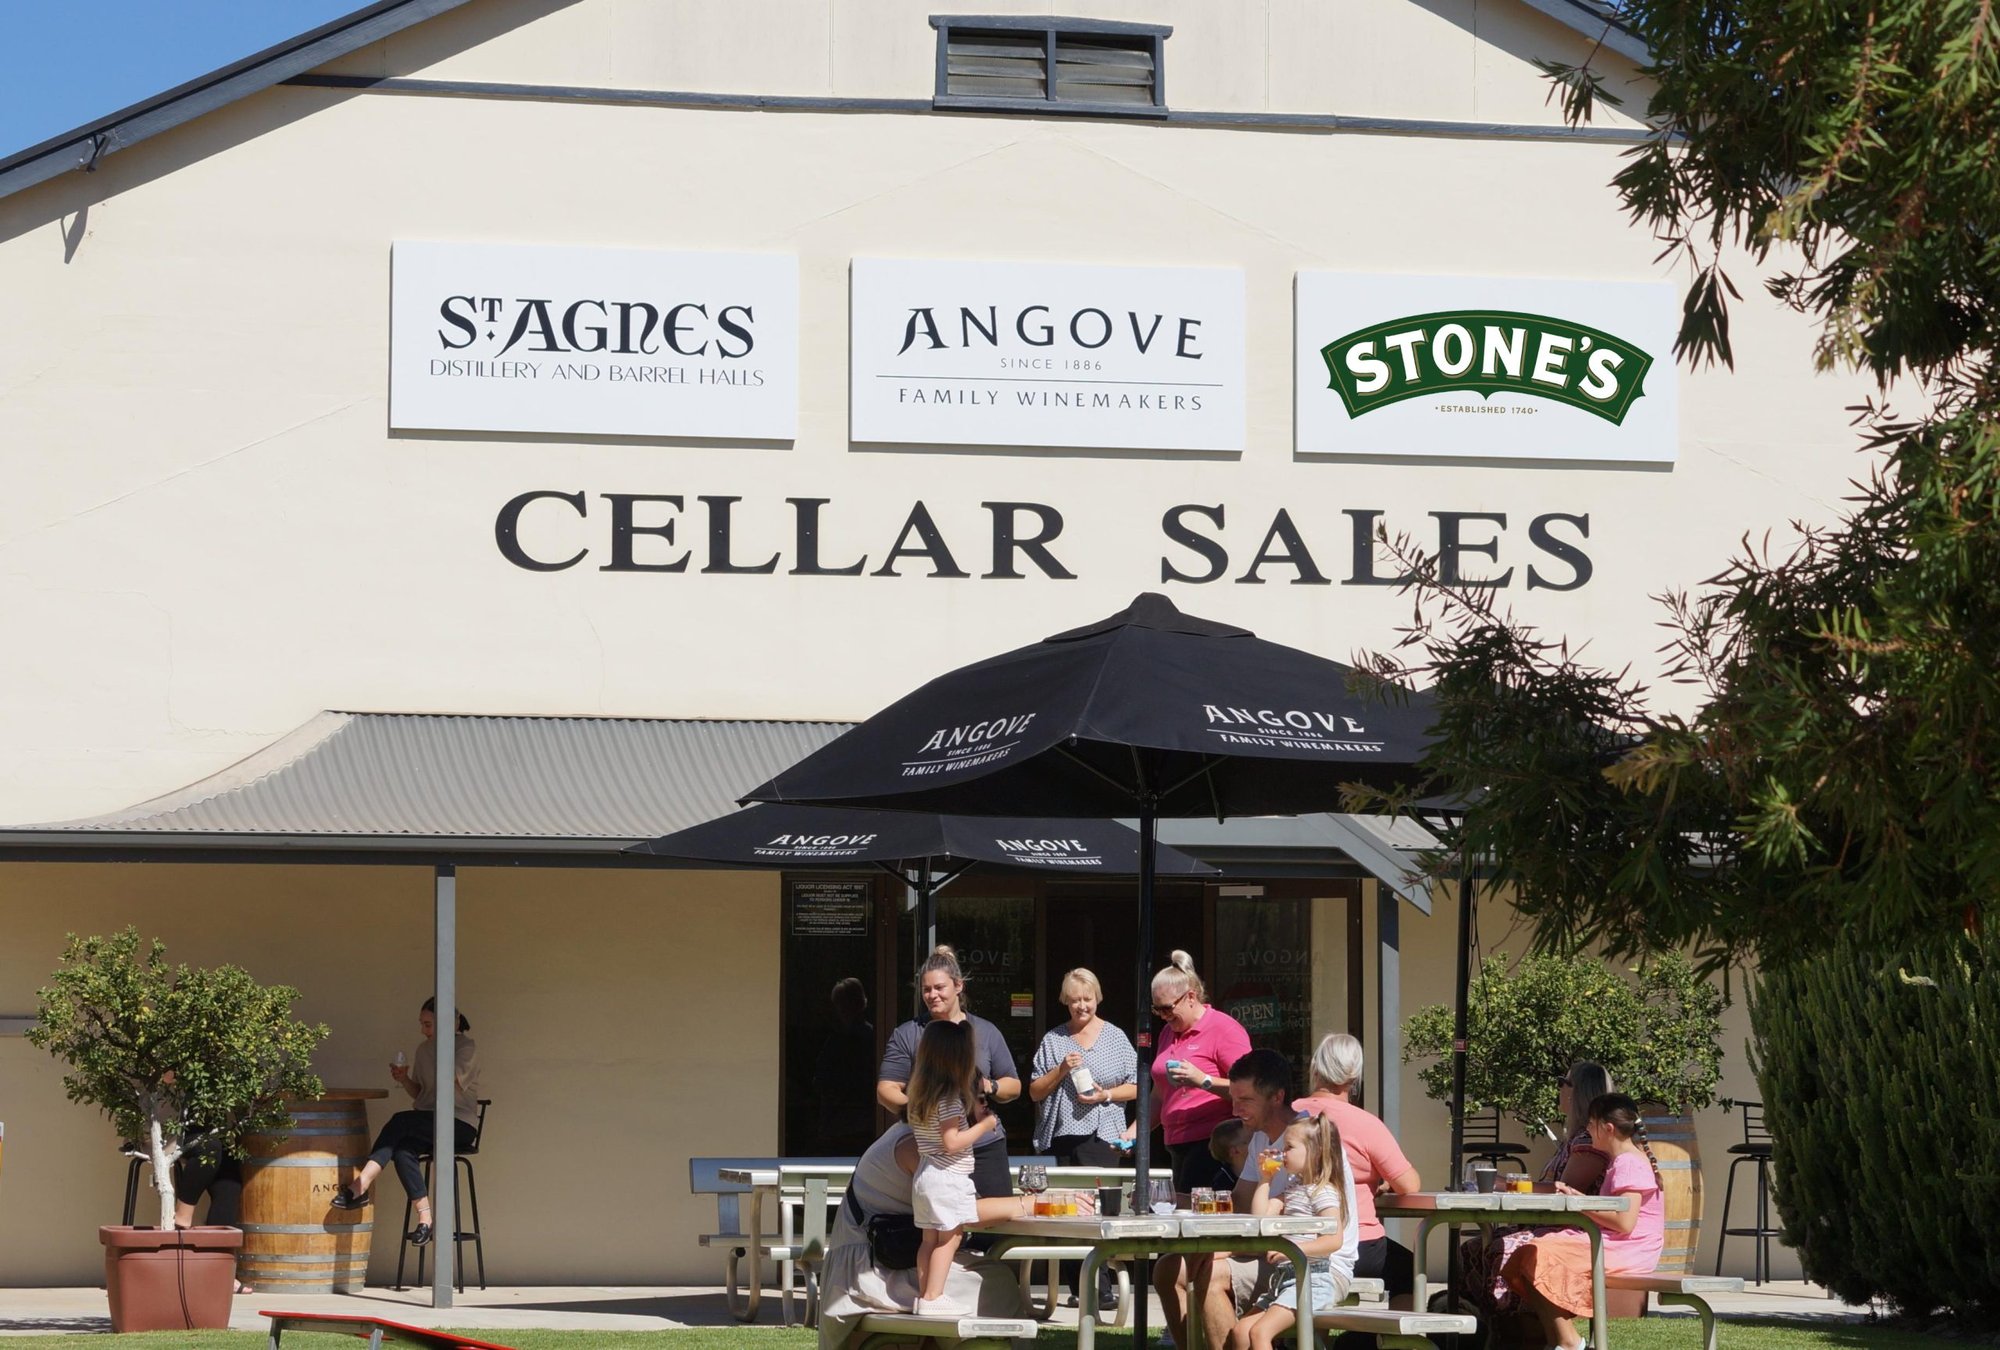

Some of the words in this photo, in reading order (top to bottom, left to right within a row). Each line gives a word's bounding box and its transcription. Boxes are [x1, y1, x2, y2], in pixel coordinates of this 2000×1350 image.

[896, 304, 1204, 361] ANGOVE
[430, 358, 542, 380] DISTILLERY
[551, 362, 600, 382] AND
[609, 365, 690, 385] BARREL
[699, 368, 765, 387] HALLS
[1000, 357, 1054, 370] SINCE
[1065, 359, 1103, 372] 1886
[1345, 323, 1626, 402] STONE'S
[899, 388, 1000, 406] FAMILY
[1017, 391, 1203, 411] WINEMAKERS
[495, 489, 1079, 580] CELLAR
[1160, 502, 1594, 592] SALES
[916, 711, 1037, 754] ANGOVE
[1202, 703, 1365, 734] ANGOVE
[1220, 734, 1276, 747] FAMILY
[1279, 740, 1383, 753] WINEMAKERS
[901, 764, 944, 777] FAMILY
[945, 747, 1011, 772] WINEMAKERS
[767, 834, 878, 846] ANGOVE
[995, 839, 1088, 852] ANGOVE
[1230, 1002, 1275, 1020] OPEN
